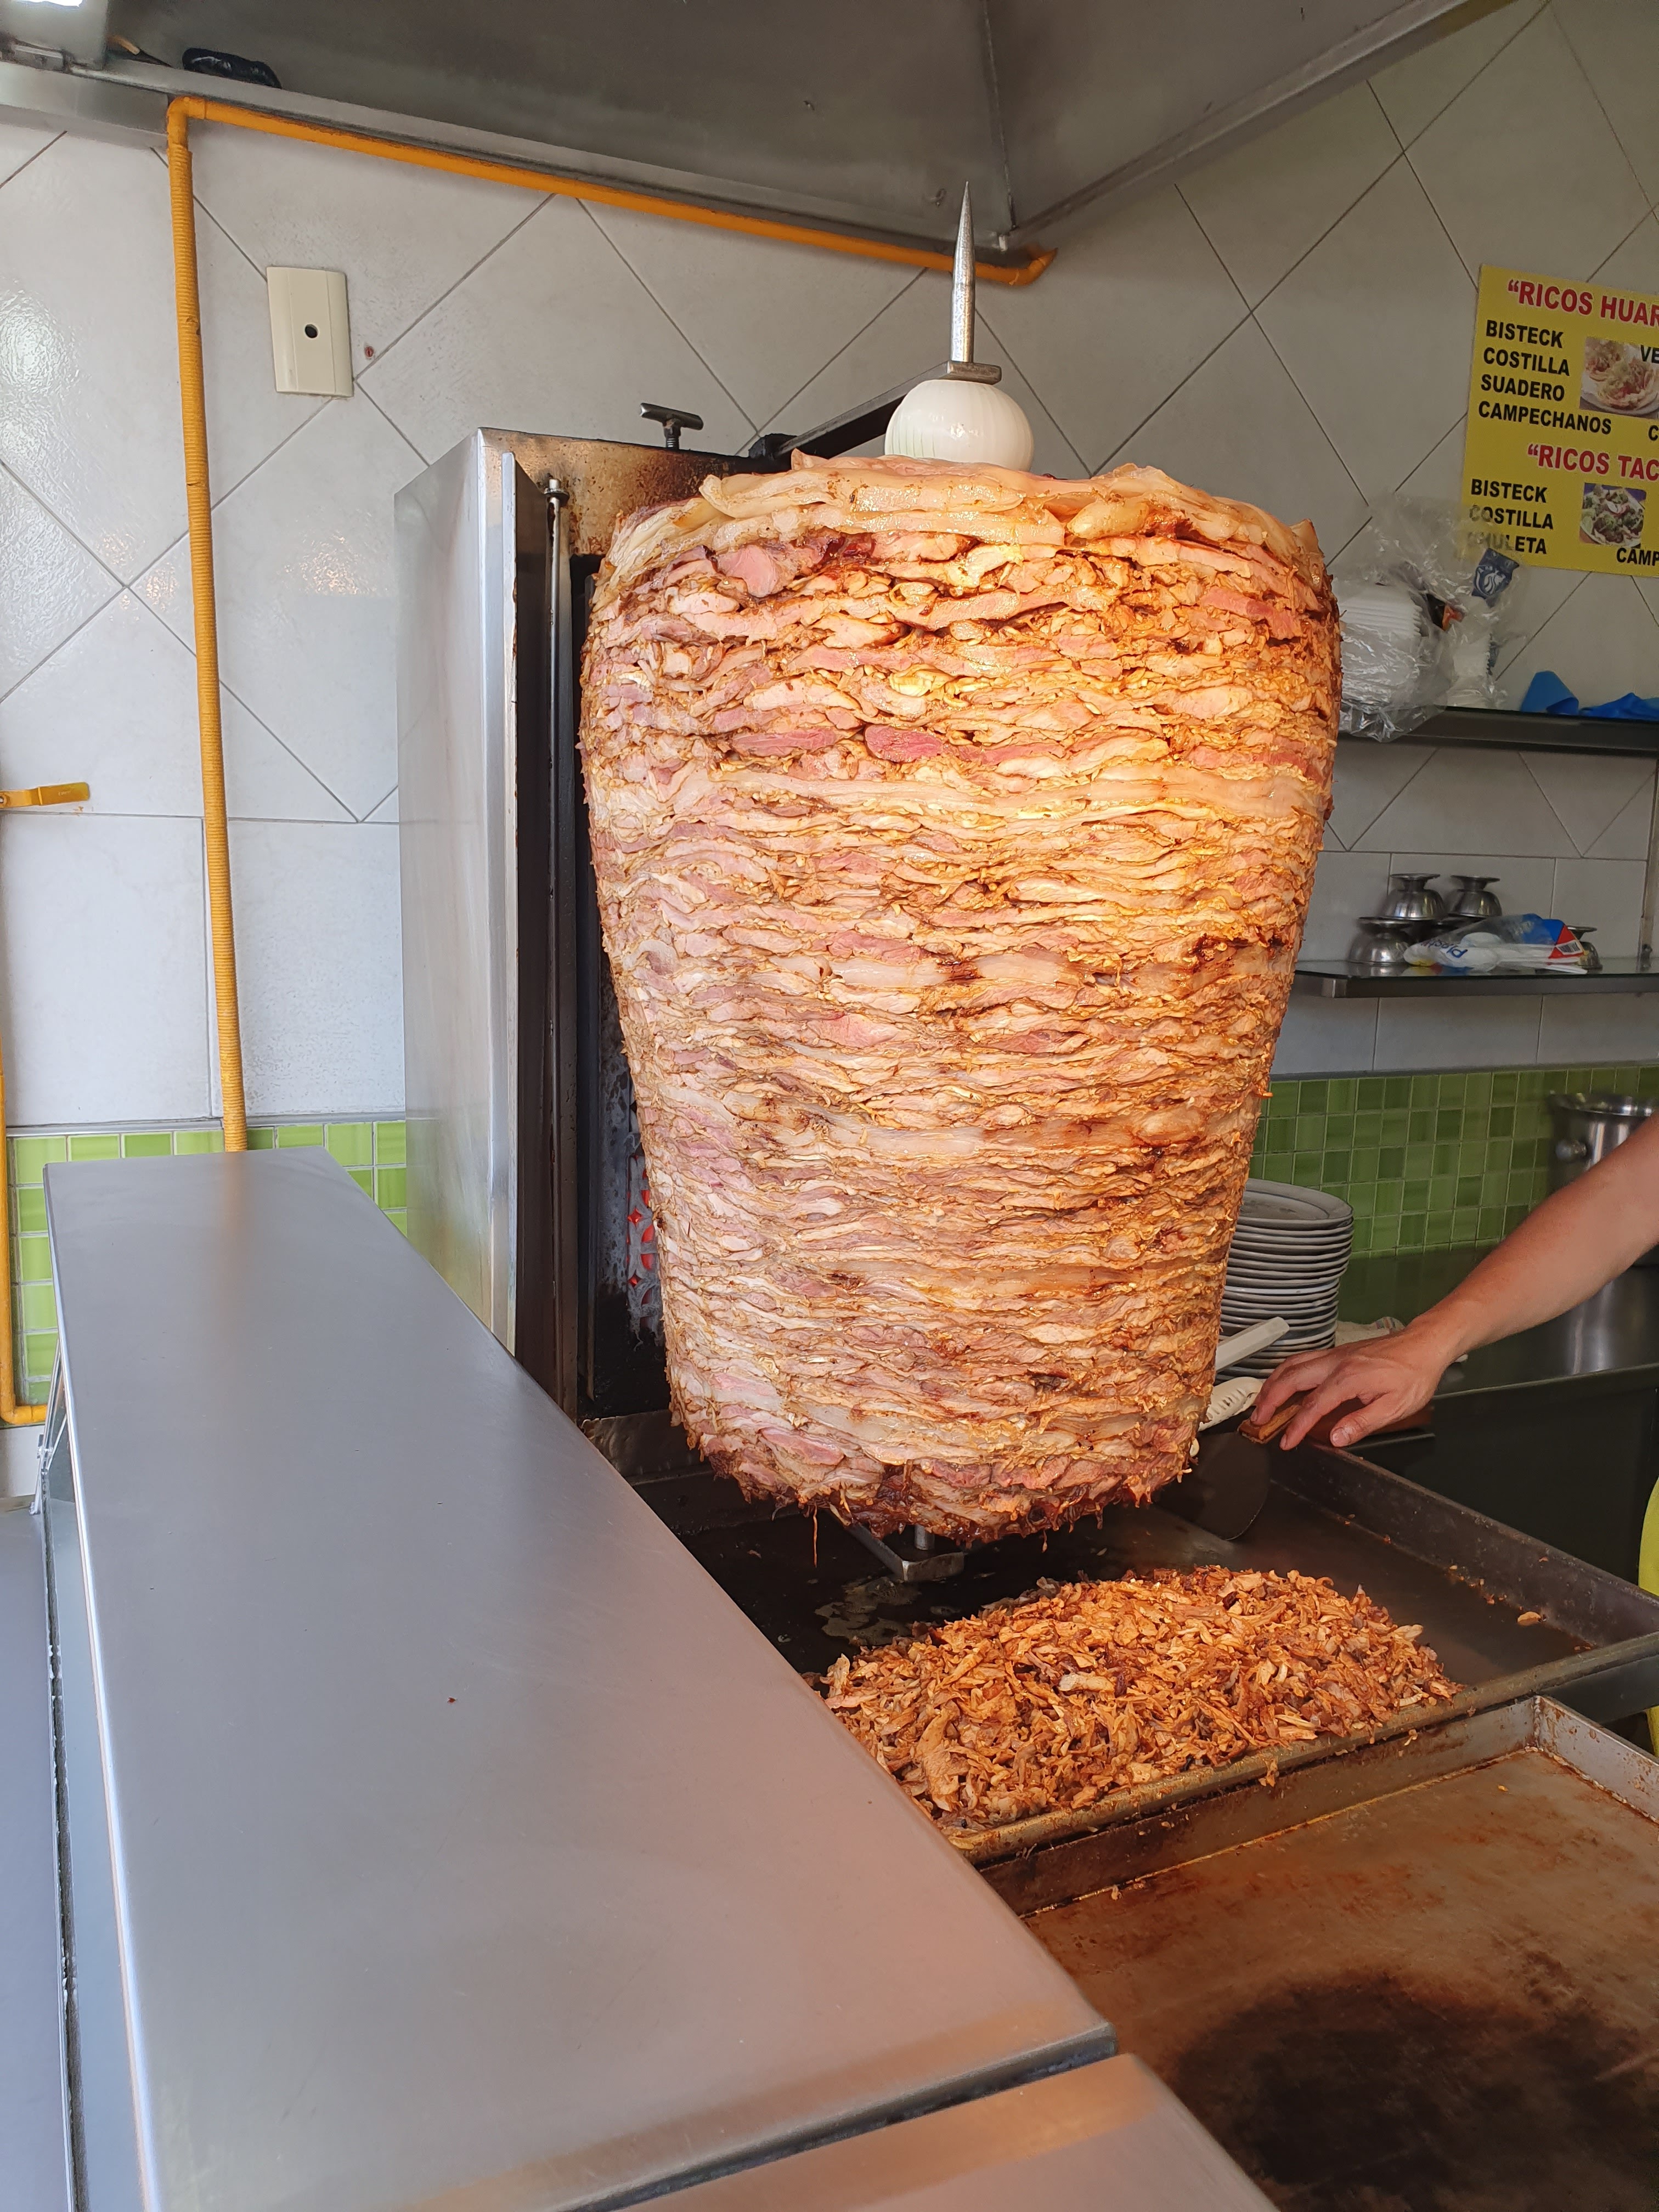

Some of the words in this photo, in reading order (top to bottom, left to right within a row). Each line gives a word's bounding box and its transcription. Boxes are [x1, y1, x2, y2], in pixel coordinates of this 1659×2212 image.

[1600, 295, 1659, 326] HUAR
[1486, 319, 1564, 348] BISTECK
[1483, 347, 1570, 376] COSTILLA
[1640, 345, 1659, 364] VE
[1481, 374, 1565, 402] SUADERO
[1479, 400, 1611, 435] CAMPECHANOS
[1618, 455, 1659, 481] TAC
[1471, 478, 1548, 503] BISTECK
[1469, 505, 1554, 530] COSTILLA
[1616, 547, 1659, 566] CAMP
